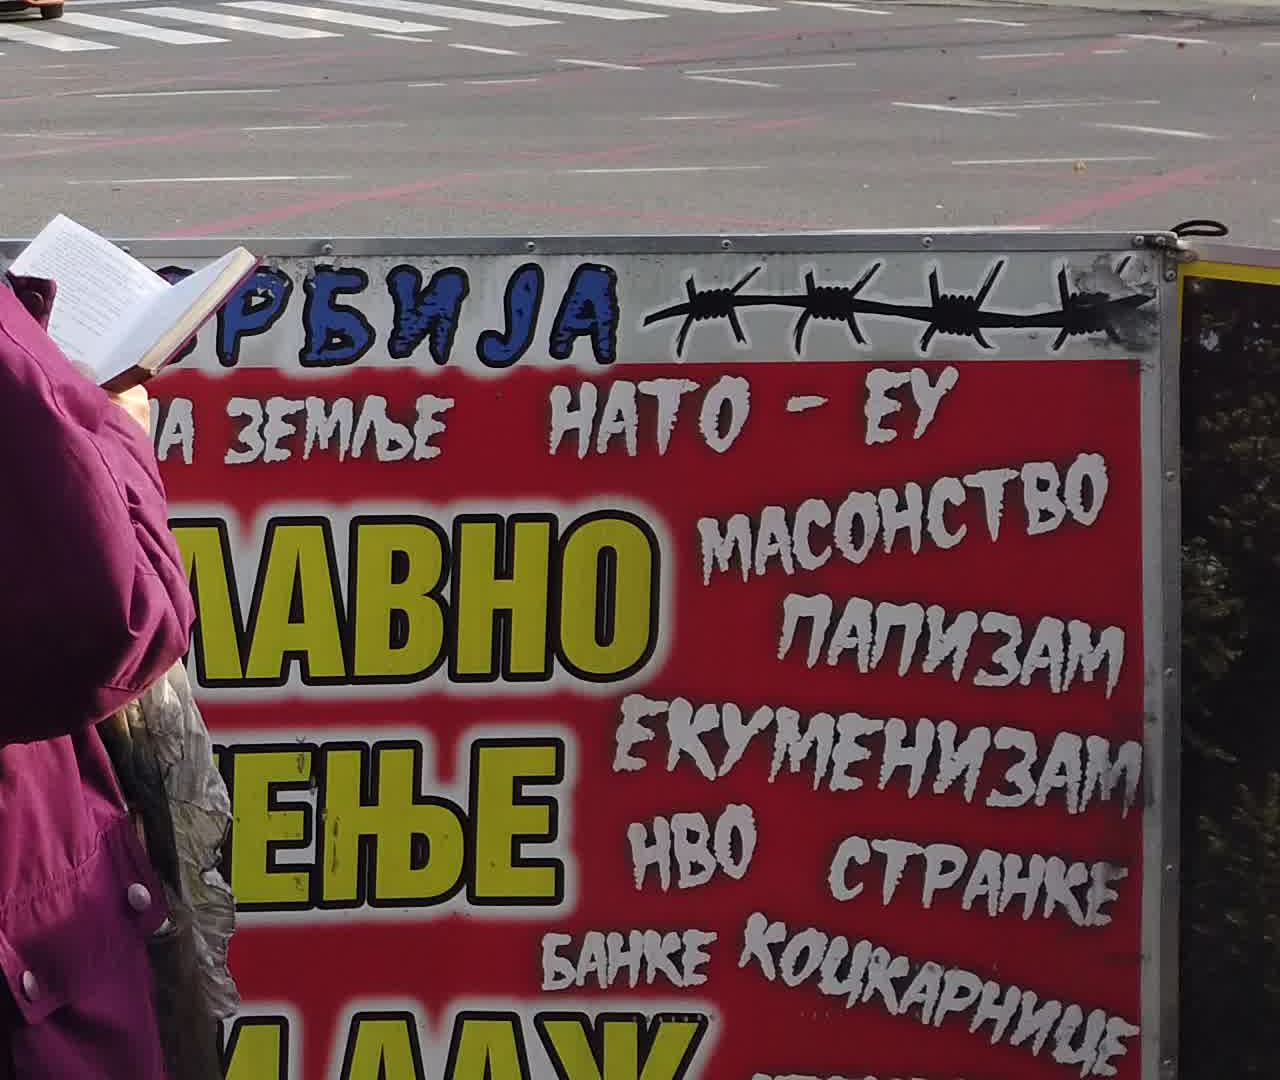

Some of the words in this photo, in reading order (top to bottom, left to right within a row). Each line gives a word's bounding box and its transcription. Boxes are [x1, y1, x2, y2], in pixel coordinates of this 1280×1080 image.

[157, 263, 620, 368] РБИЈА
[224, 394, 455, 465] ЗЕМЉЕ
[549, 377, 750, 458] НАТО
[864, 366, 960, 446] ЕУ
[697, 453, 1109, 586] МАСОНСТВО
[777, 593, 1126, 699] ПАПИЗАМ
[613, 694, 1142, 819] ЕКУМЕНИЗАМ
[214, 738, 564, 912] ЕЊЕ
[627, 804, 757, 892] НВО
[828, 836, 1128, 928] СТРАНКЕ
[542, 929, 717, 991] БАНКЕ
[739, 913, 1140, 1078] КОЦКАРНИЦЕ
